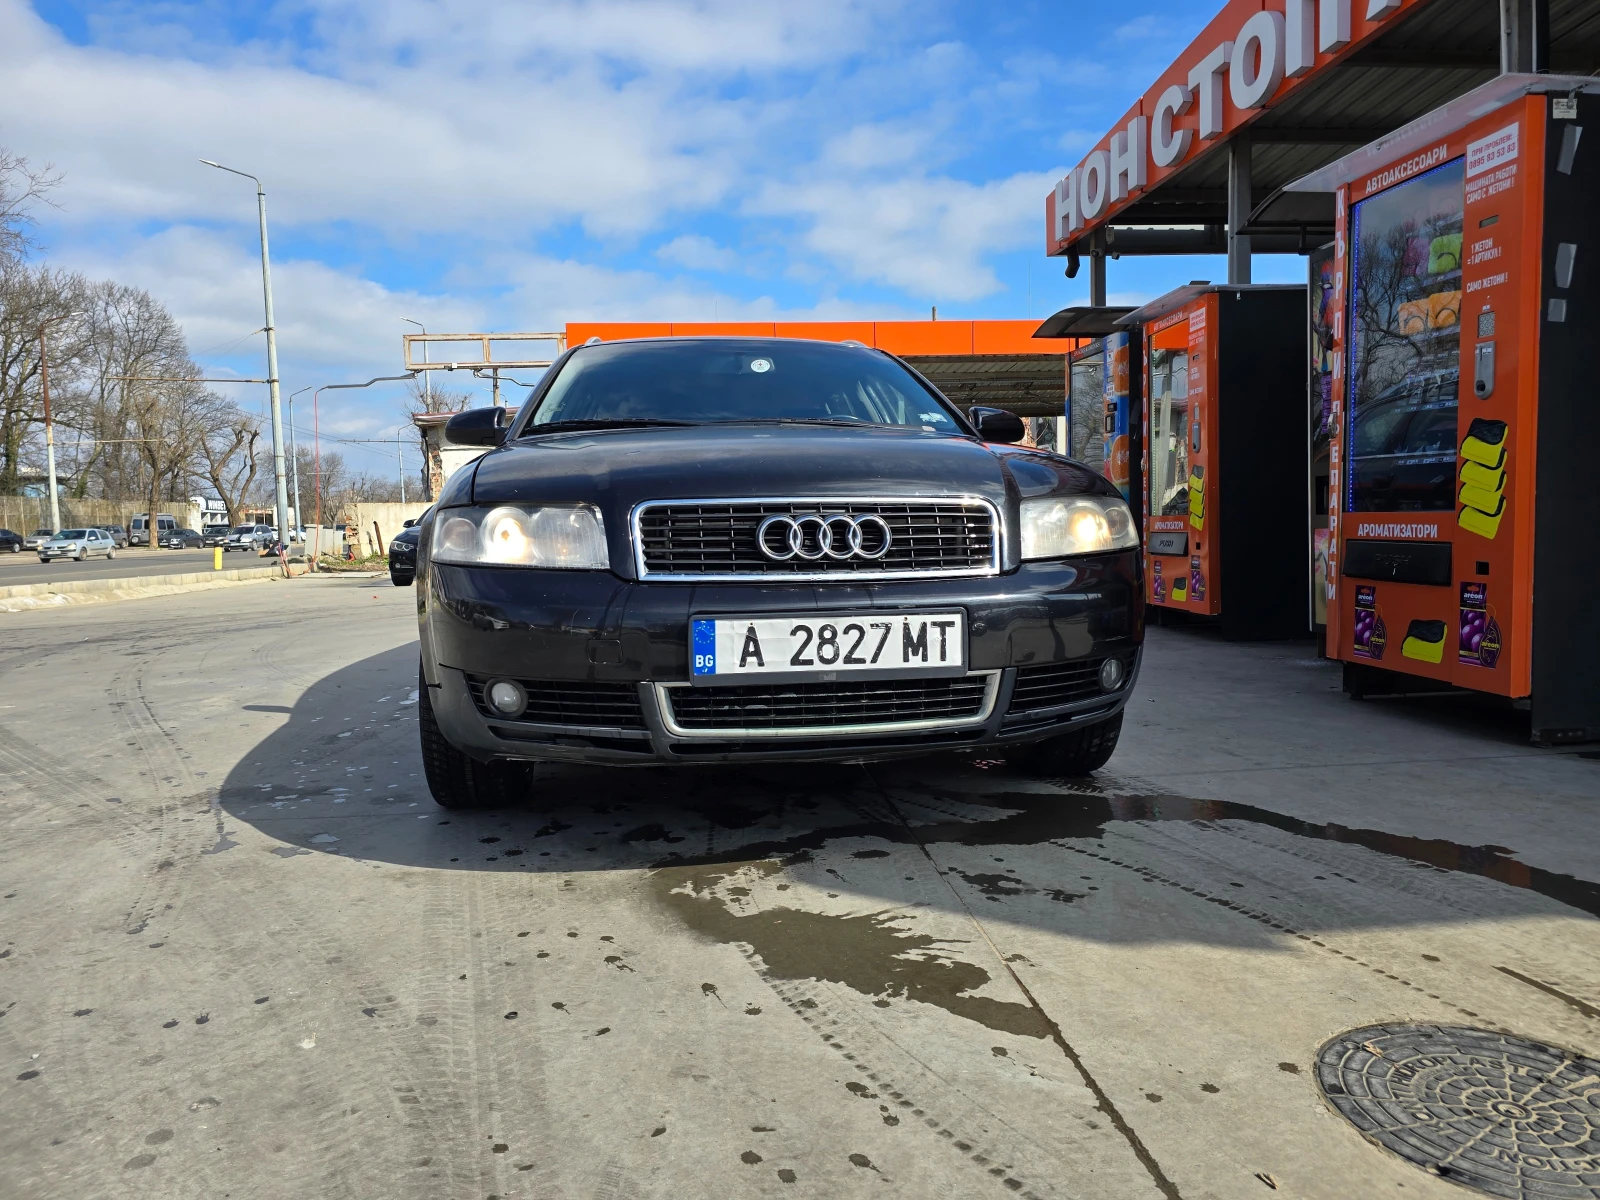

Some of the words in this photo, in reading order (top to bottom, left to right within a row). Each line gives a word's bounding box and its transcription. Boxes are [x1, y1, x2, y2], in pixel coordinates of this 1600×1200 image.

[1469, 156, 1485, 170] 0895
[1486, 151, 1495, 162] 83
[1496, 147, 1505, 158] 53
[1506, 142, 1516, 154] 83
[1471, 146, 1483, 158] ПРИ
[1365, 144, 1448, 194] АВТОАКСЕСОАРИ
[1465, 173, 1495, 194] МАШИНАТА
[1495, 164, 1518, 181] РАБОТИ
[1466, 189, 1481, 205] САМО
[1474, 237, 1493, 253] ЖЕТОН
[1333, 188, 1346, 380] КЪРПИ
[1466, 279, 1482, 293] САМО
[1357, 523, 1438, 538] АРОМАТИЗАТОРИ
[738, 624, 765, 667] A
[790, 622, 892, 666] 2827
[902, 621, 955, 663] MT
[695, 655, 714, 667] BG
